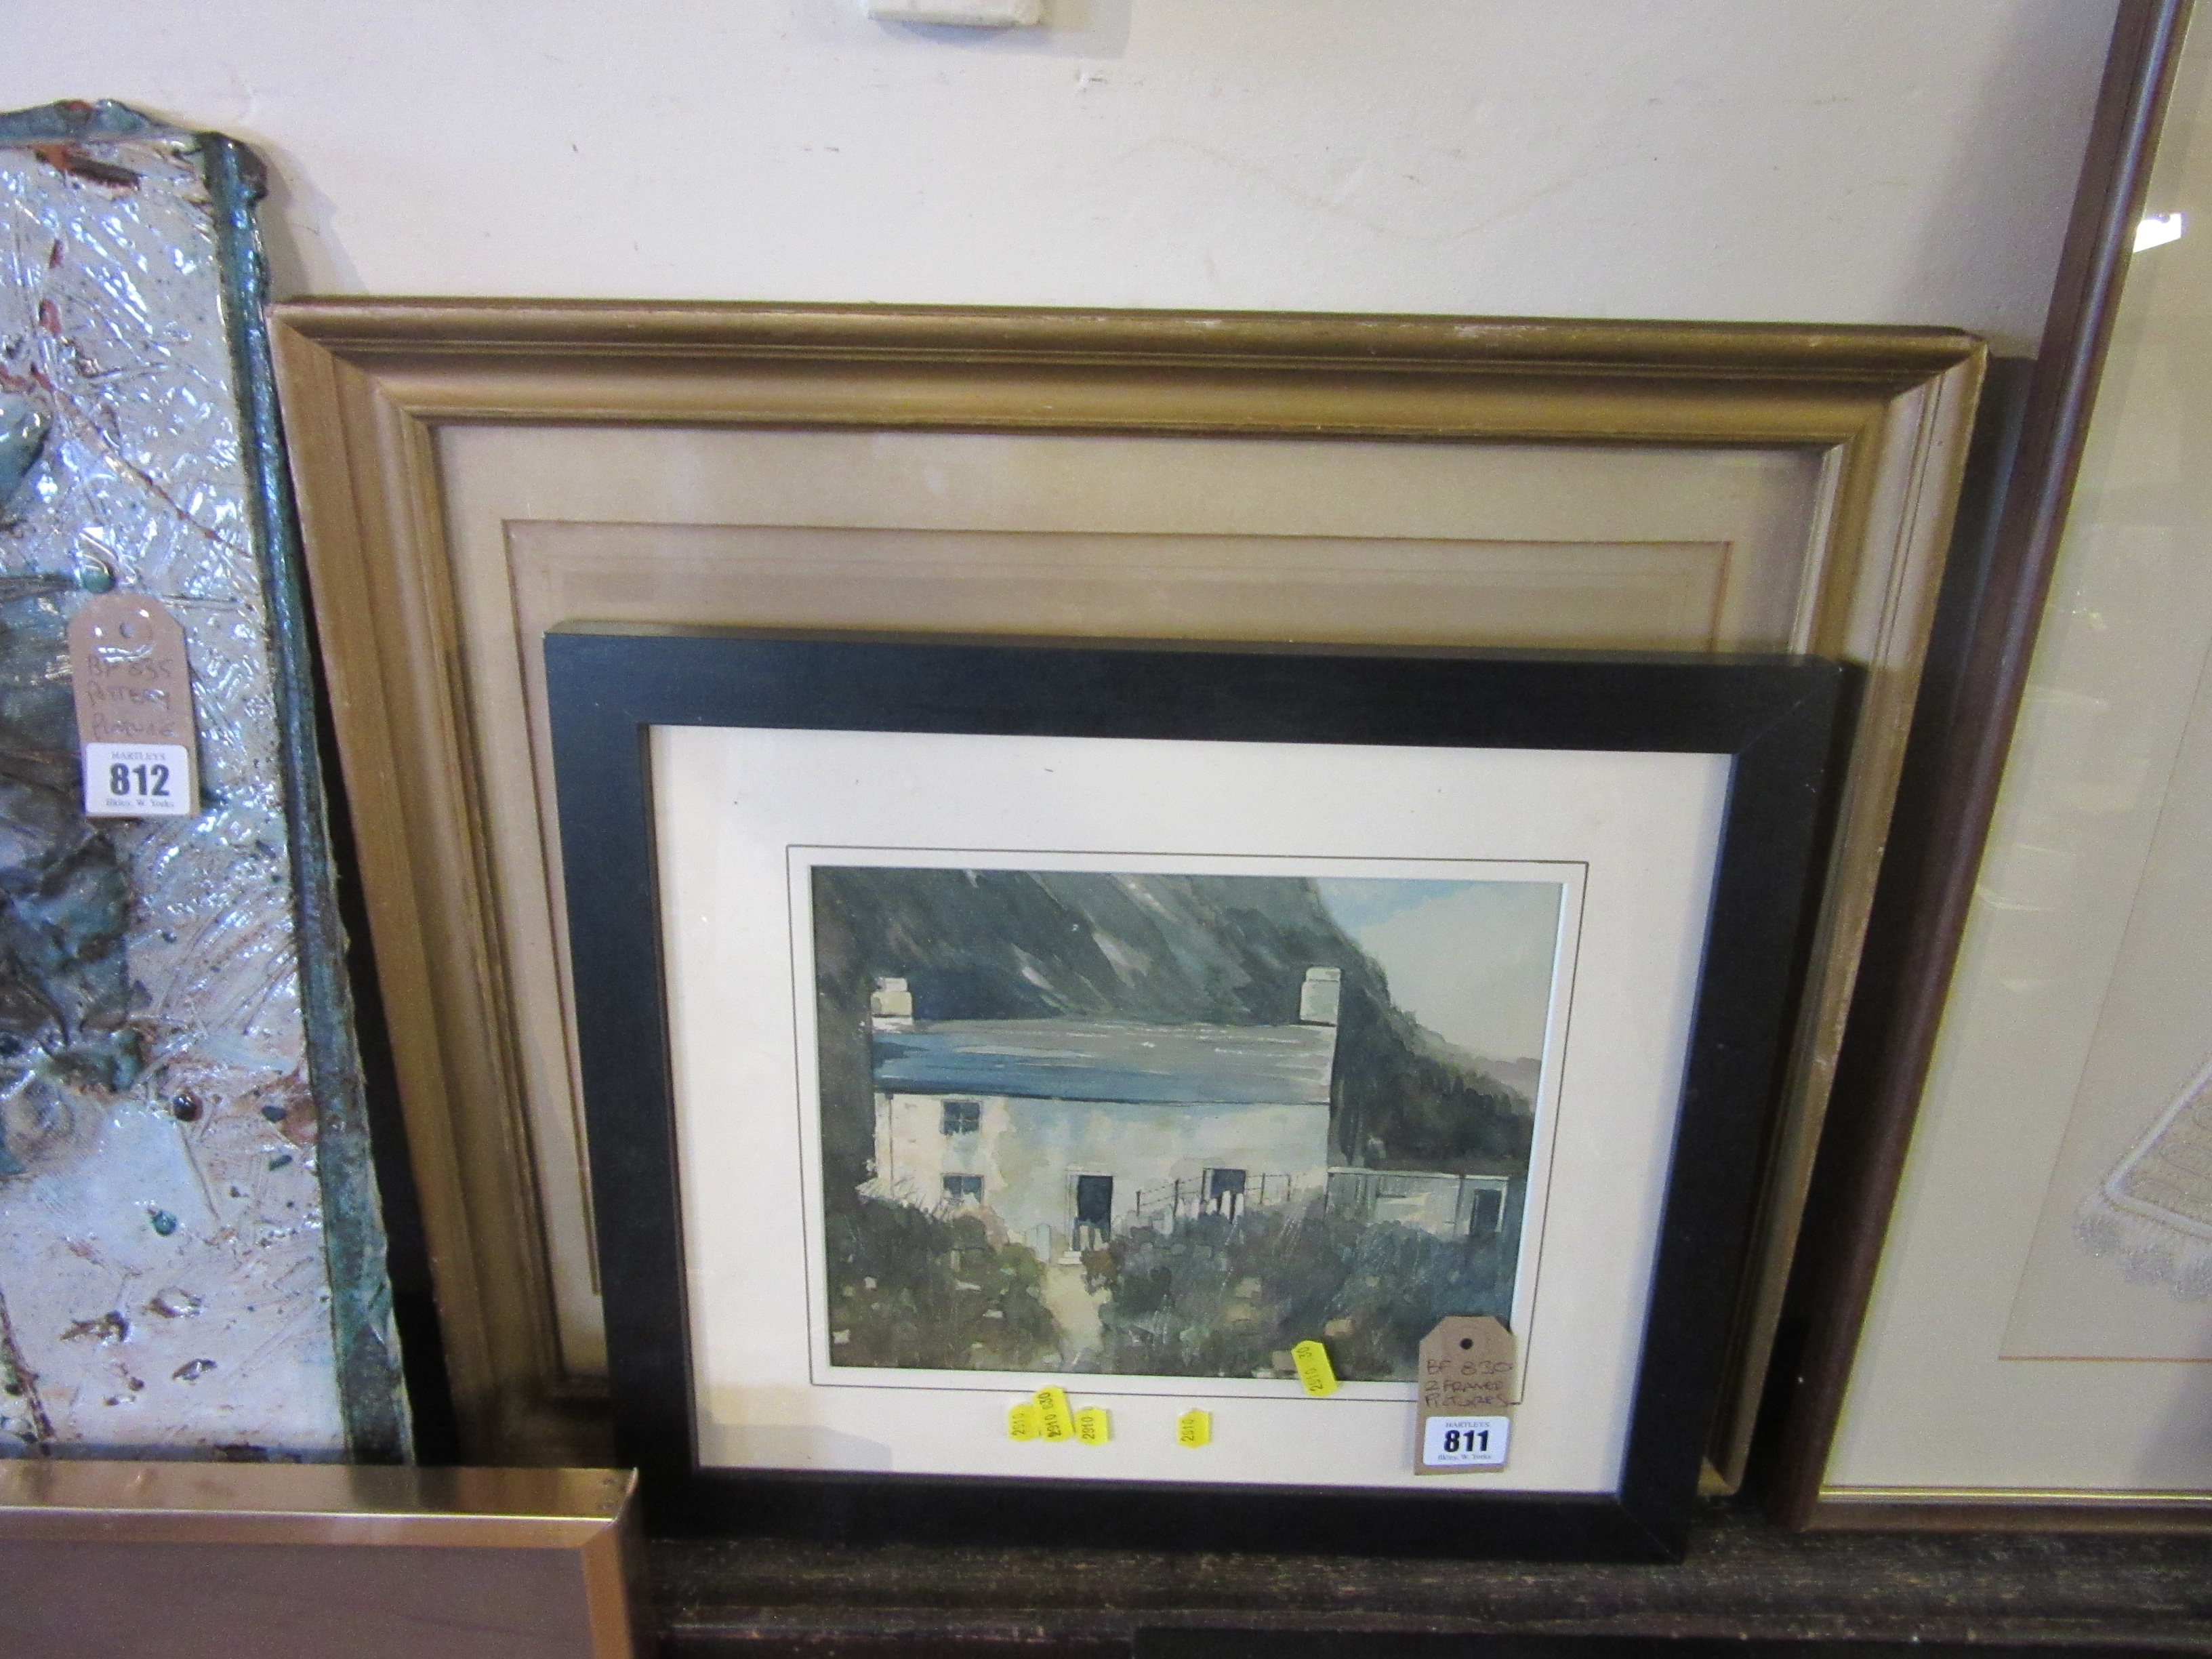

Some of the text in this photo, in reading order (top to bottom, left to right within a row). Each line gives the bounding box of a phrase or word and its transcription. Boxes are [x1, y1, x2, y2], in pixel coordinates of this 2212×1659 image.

[112, 751, 166, 762] HARTLEYS
[110, 763, 170, 796] 812
[1427, 1359, 1513, 1376] BF 830
[1425, 1380, 1439, 1391] 2
[1045, 1414, 1061, 1437] 2910
[1081, 1416, 1094, 1439] 2910
[1444, 1429, 1489, 1452] 811
